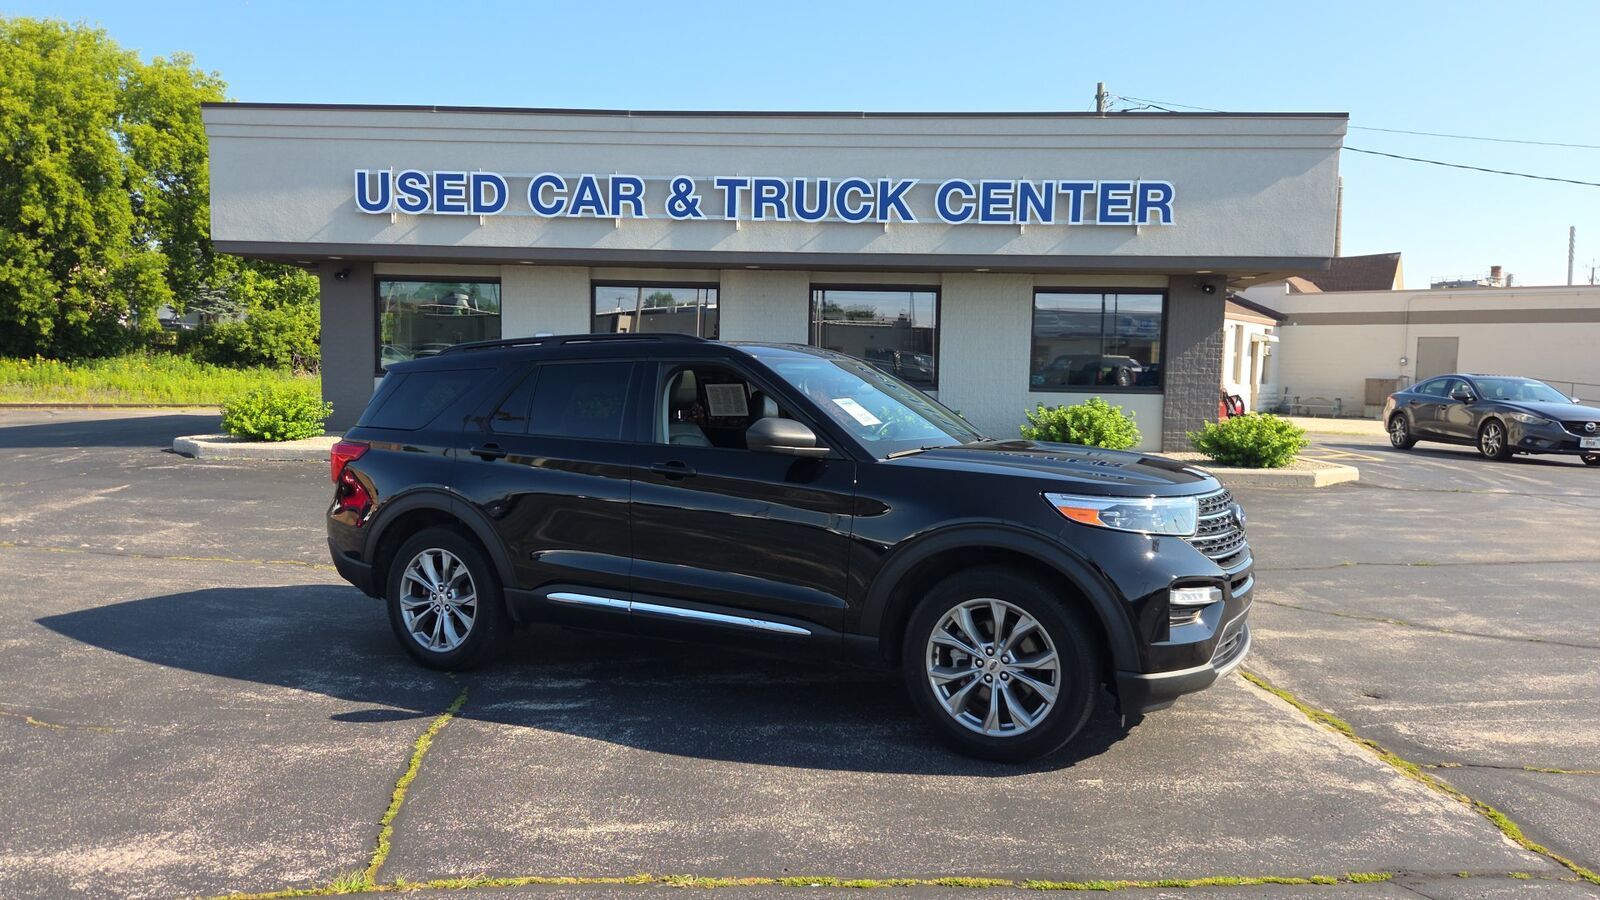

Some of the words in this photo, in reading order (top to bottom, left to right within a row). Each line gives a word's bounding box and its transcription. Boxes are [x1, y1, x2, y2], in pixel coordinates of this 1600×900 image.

[355, 170, 508, 214] USED
[528, 173, 646, 217] CAR
[665, 176, 704, 219] &
[715, 177, 915, 222] TRUCK
[936, 179, 1174, 224] CENTER
